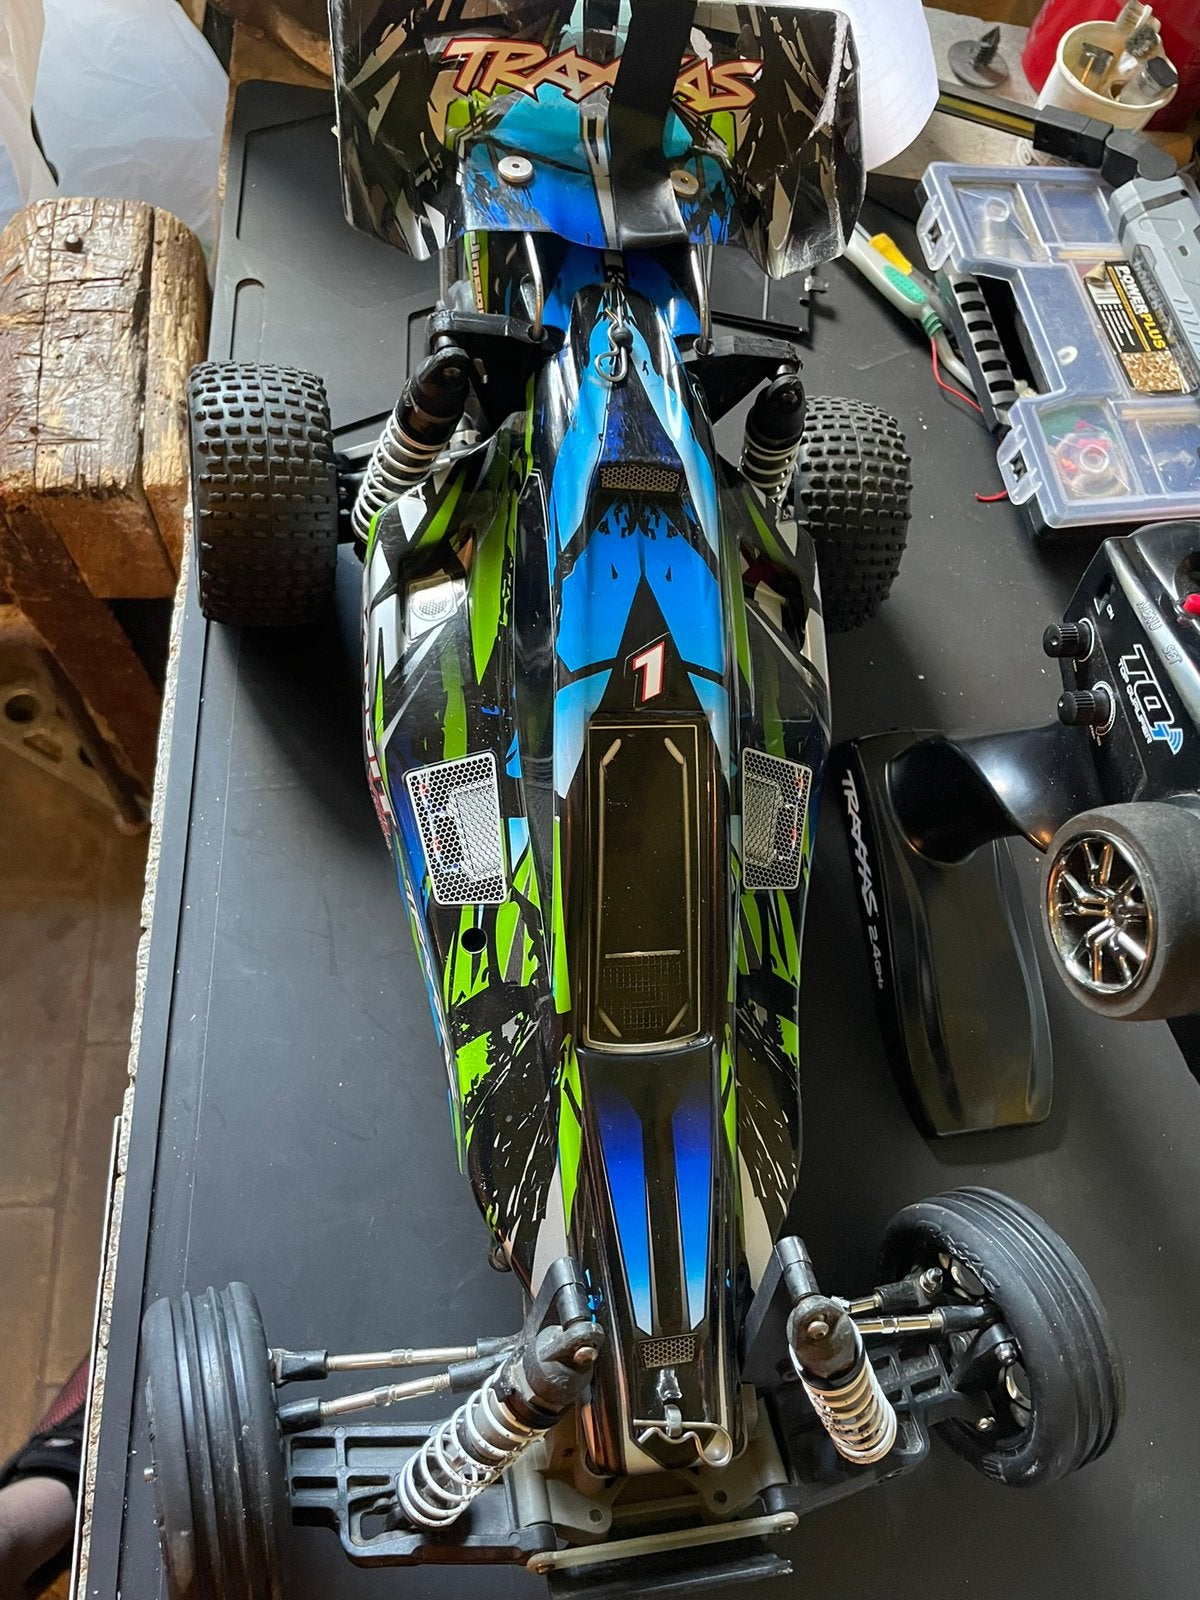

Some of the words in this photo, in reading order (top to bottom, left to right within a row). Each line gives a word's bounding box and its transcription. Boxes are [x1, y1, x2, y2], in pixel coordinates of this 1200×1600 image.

[441, 37, 764, 115] TRAXAS
[1136, 600, 1162, 631] MENU
[632, 641, 665, 703] 1
[1162, 645, 1182, 665] SET
[1118, 657, 1130, 683] TOP
[1126, 684, 1153, 744] QUALIFIER
[841, 769, 879, 917] TRAXXAS
